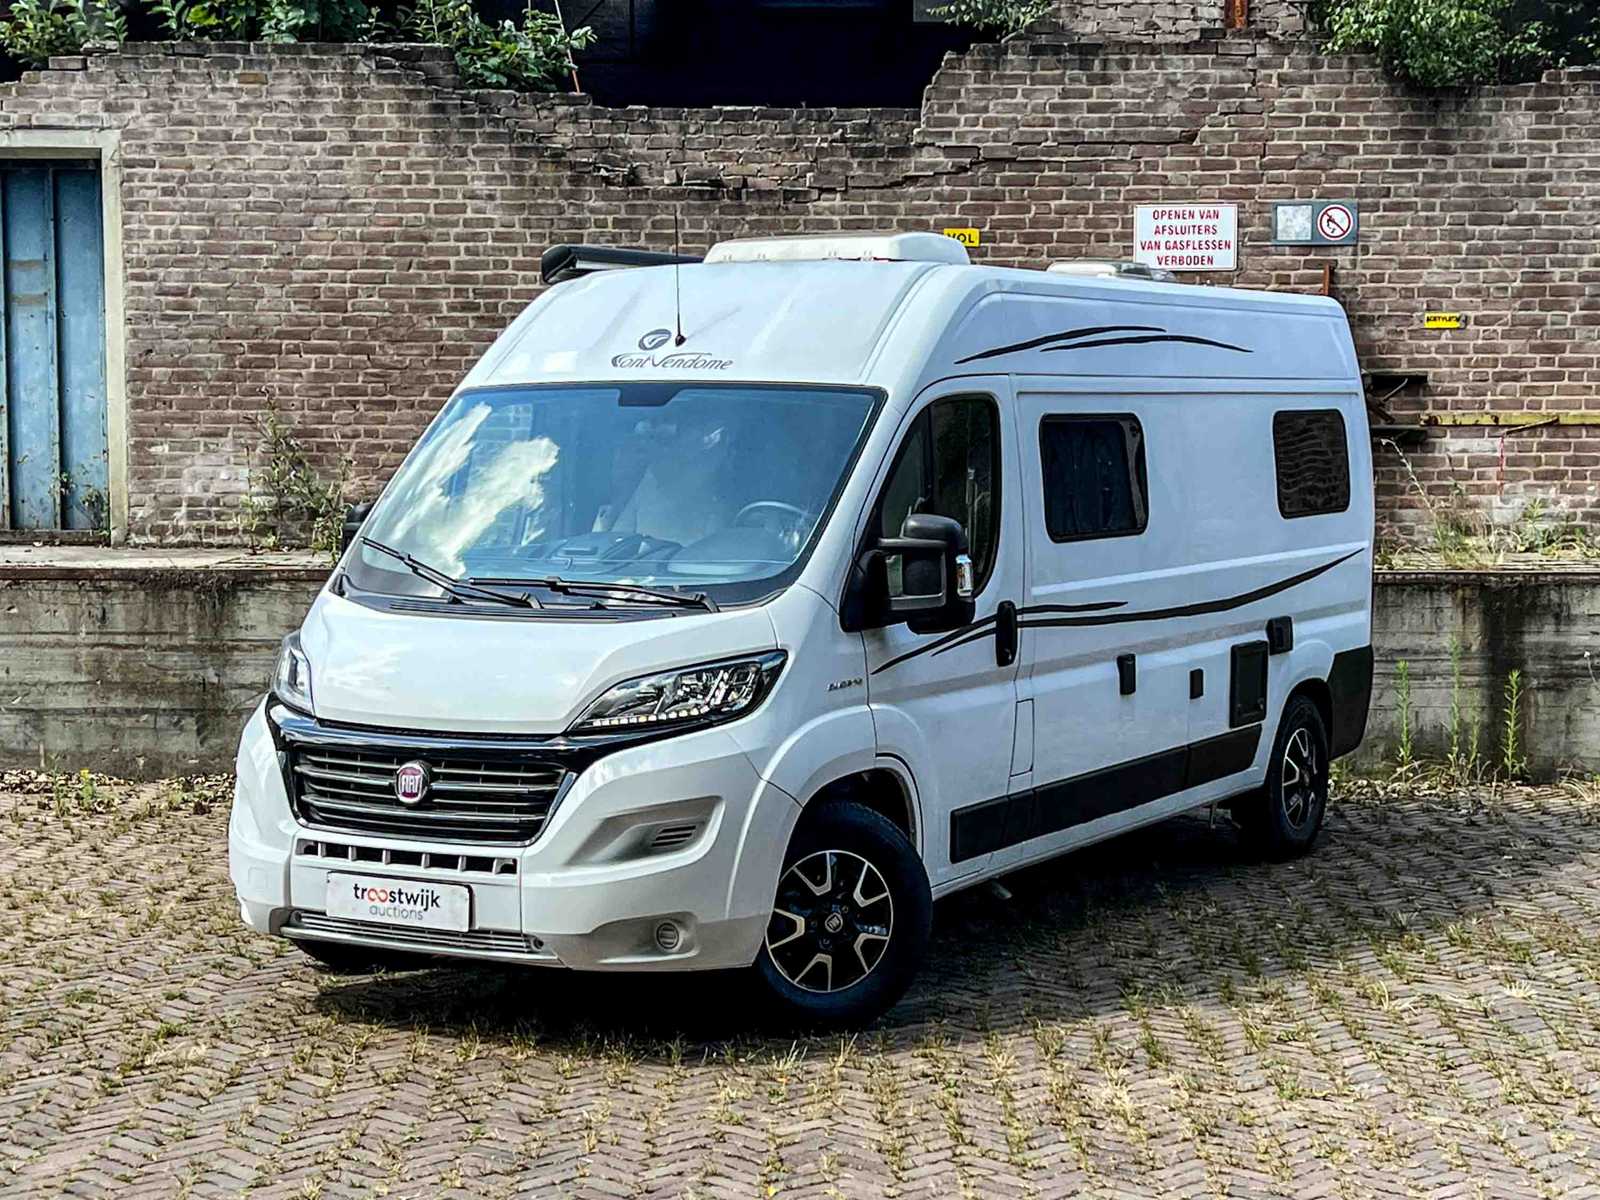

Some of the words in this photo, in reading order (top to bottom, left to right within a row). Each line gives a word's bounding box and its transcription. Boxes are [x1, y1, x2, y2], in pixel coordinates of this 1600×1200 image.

[1152, 209, 1195, 220] OPENEN
[1199, 209, 1220, 220] VAN
[1153, 224, 1218, 236] AFSLUITERS
[1140, 240, 1161, 251] VAN
[1164, 239, 1232, 251] GASFLESSEN
[1156, 255, 1215, 266] VERBODEN
[401, 775, 421, 793] FIAT
[353, 883, 441, 912] troostwijk
[369, 904, 424, 920] auctions
